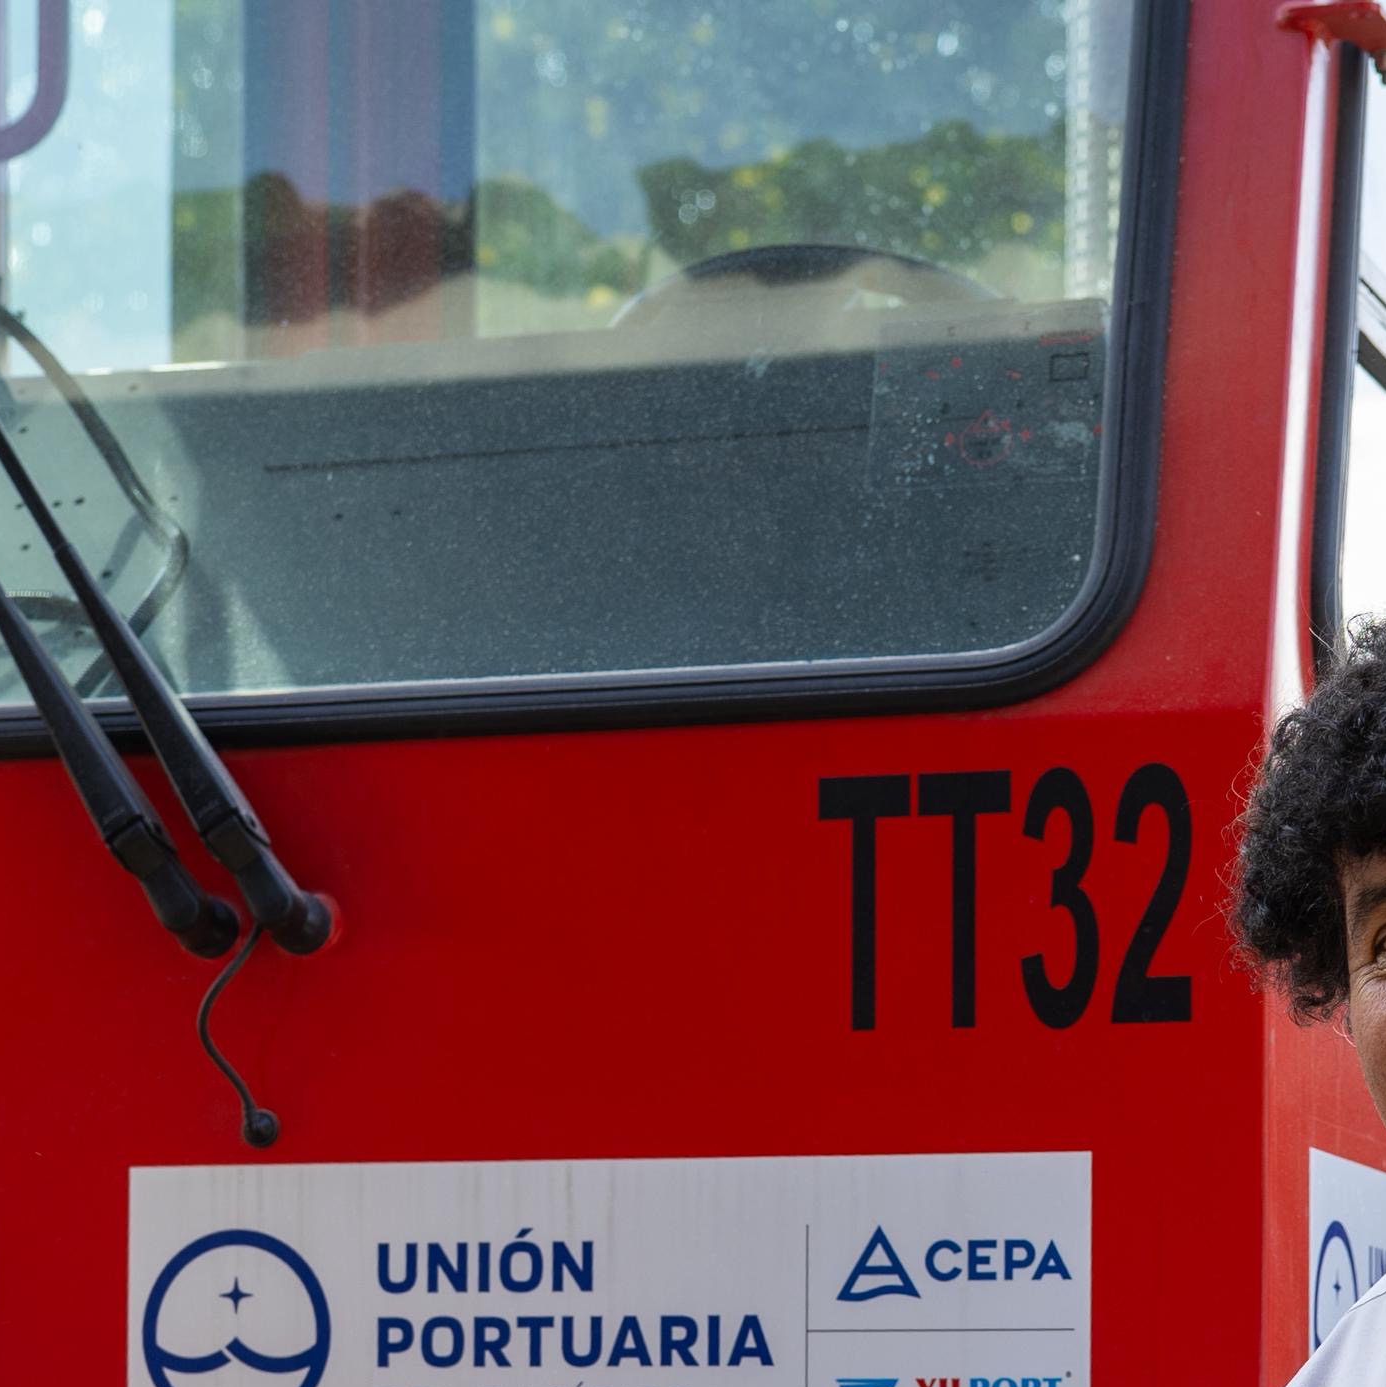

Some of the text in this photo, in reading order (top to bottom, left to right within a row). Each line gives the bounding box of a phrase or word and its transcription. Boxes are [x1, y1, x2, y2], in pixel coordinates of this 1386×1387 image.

[818, 761, 1193, 1032] TT32
[377, 1227, 594, 1294] UNIÓN
[924, 1238, 1073, 1282] CEPA
[376, 1314, 775, 1368] PORTUARIA
